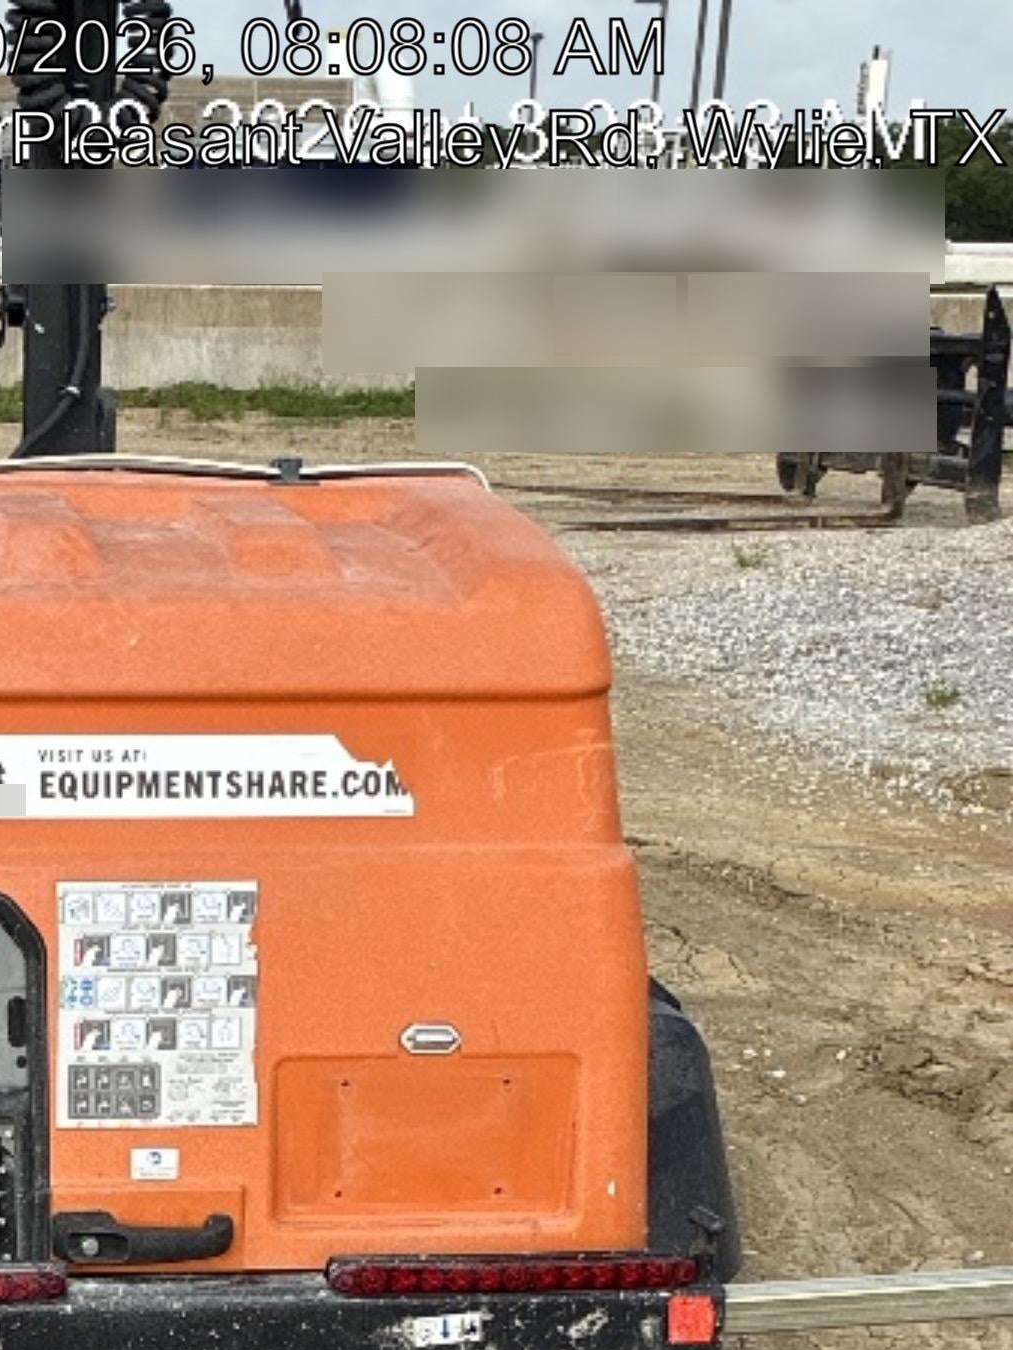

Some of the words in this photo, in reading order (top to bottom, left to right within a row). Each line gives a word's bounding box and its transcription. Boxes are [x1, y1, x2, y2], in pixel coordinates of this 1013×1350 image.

[37, 749, 85, 763] VISIT
[91, 749, 115, 763] US
[39, 769, 408, 801] EQUIPMENTSHARE.COM
